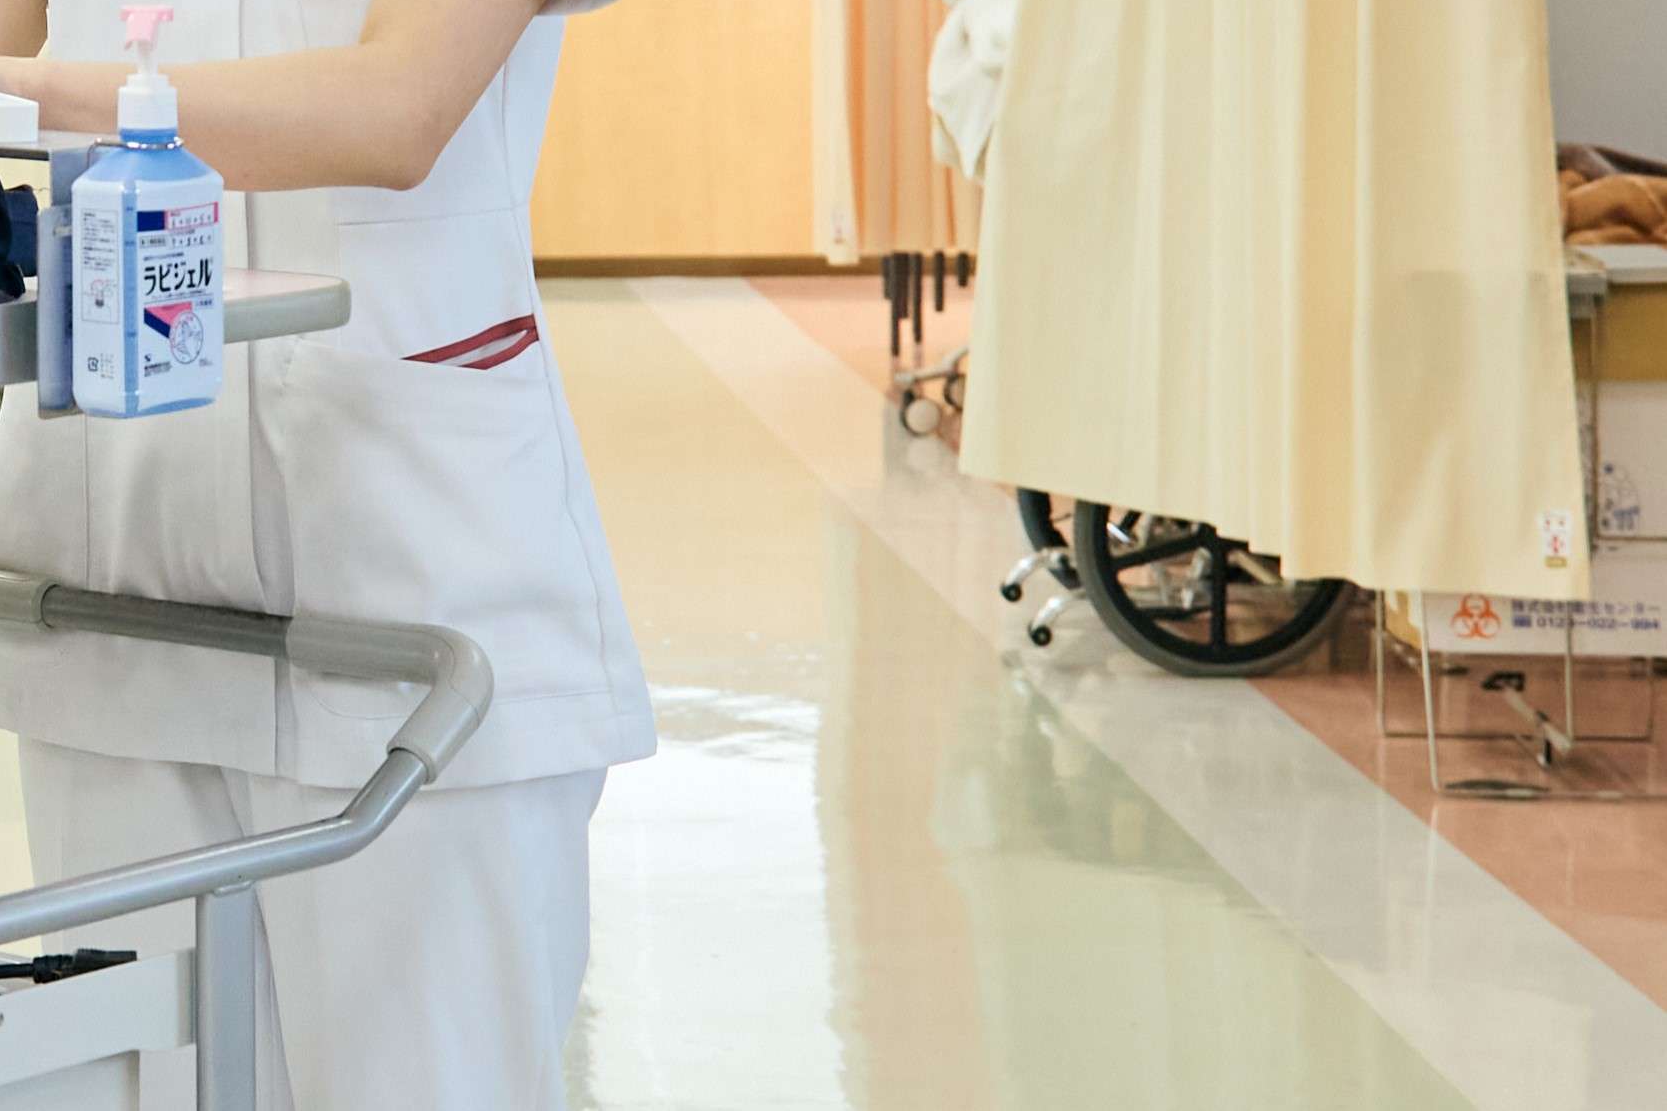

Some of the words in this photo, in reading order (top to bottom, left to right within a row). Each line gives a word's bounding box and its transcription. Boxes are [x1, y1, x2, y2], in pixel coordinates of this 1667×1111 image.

[144, 258, 213, 296] ラビジェル
